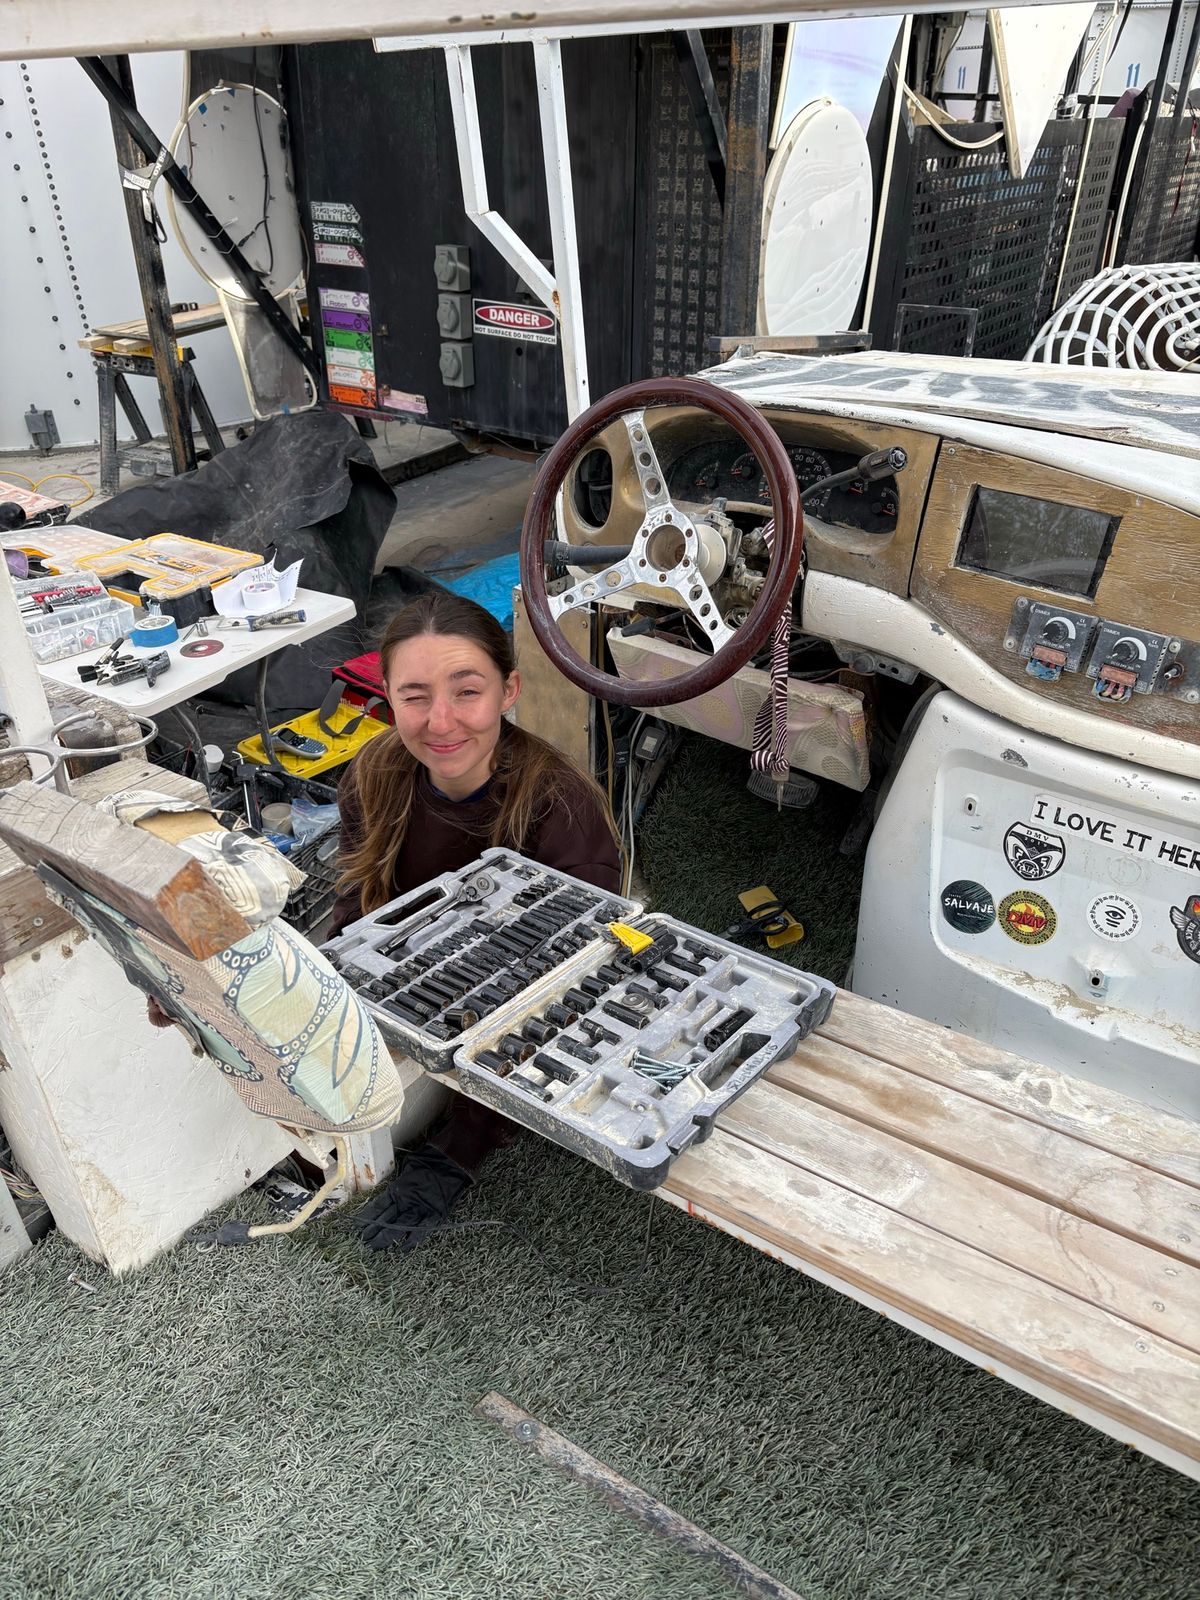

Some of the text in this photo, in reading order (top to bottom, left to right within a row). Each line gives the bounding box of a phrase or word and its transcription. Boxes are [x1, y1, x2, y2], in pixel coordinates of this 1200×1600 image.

[489, 308, 540, 327] DANGER
[487, 328, 513, 337] SURFACE
[536, 335, 556, 343] TOUCH
[813, 464, 822, 472] 70
[1034, 608, 1051, 616] DIMMER
[1103, 627, 1121, 636] DIMMER
[1034, 801, 1048, 820] I
[1053, 807, 1117, 843] LOVE
[1122, 829, 1152, 852] IT
[1026, 829, 1049, 842] DMV
[944, 897, 994, 914] SALVAJE
[1007, 909, 1048, 929] DMV
[1185, 922, 1197, 941] BLACK
